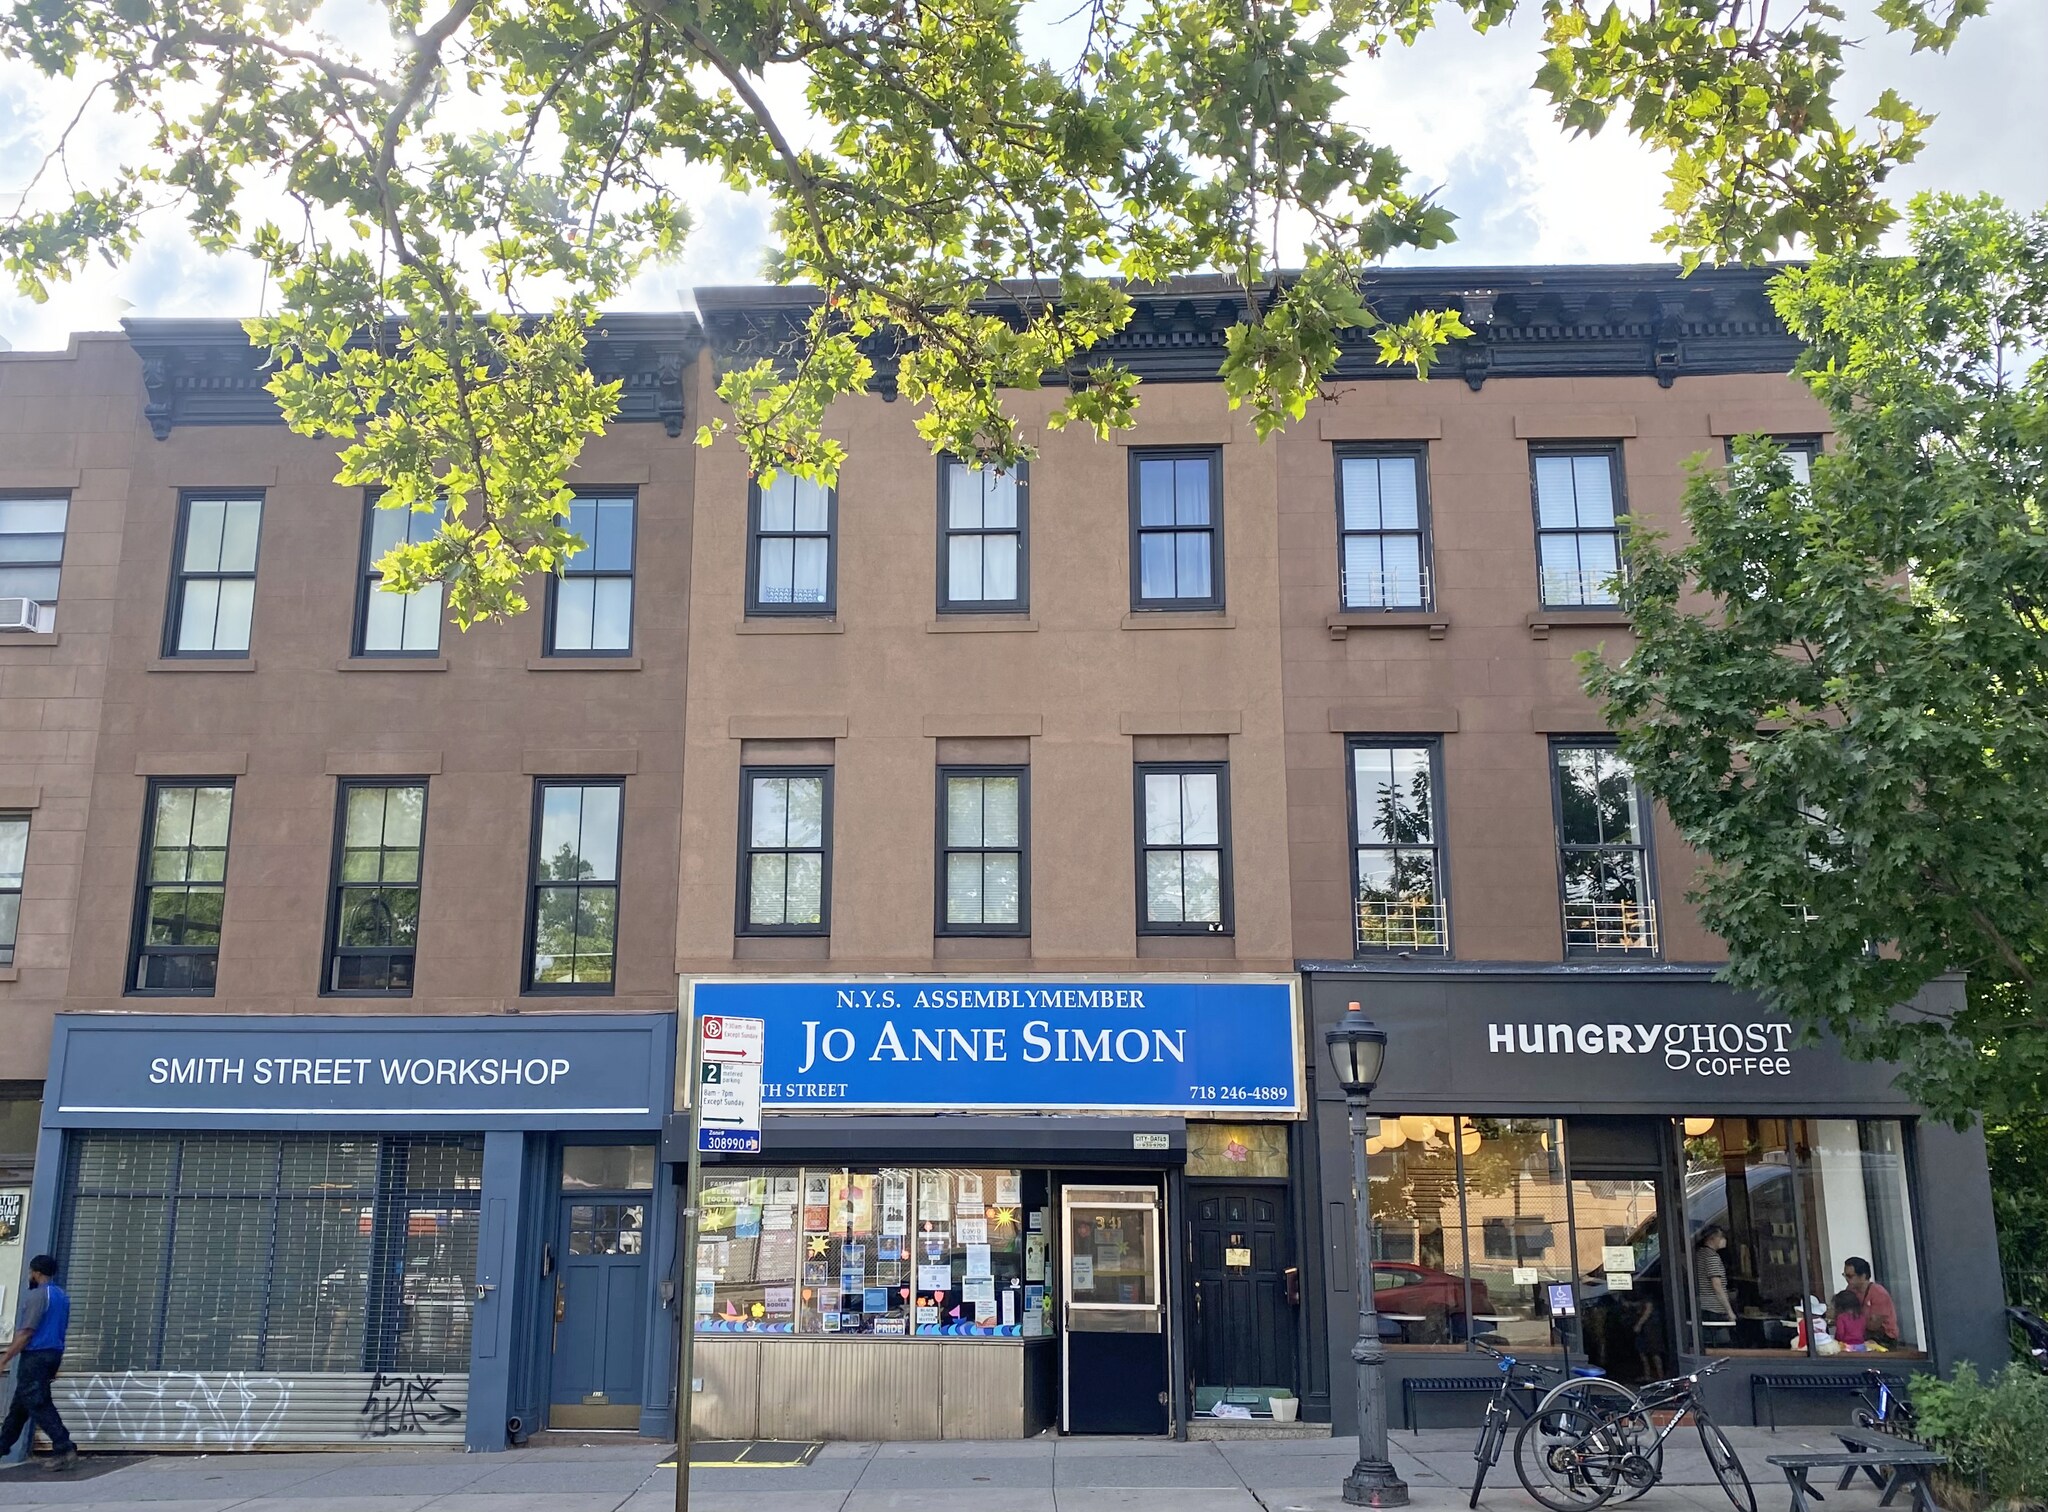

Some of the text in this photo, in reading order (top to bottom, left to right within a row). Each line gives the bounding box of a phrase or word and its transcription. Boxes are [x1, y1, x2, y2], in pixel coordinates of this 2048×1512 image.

[836, 990, 1145, 1008] N.Y.S. ASSEMBLYMEMBER
[149, 1057, 570, 1085] SMITH STREET WORKSHOP
[707, 1064, 717, 1082] 2
[703, 1088, 716, 1096] 8am
[722, 1089, 733, 1097] 7pm
[786, 1083, 848, 1098] STREET
[1189, 1086, 1288, 1101] 718 246-4889
[725, 1098, 744, 1107] Sunday
[708, 1137, 745, 1150] 308990
[876, 1324, 903, 1333] PRIDE
[1667, 1408, 1685, 1431] HARO
